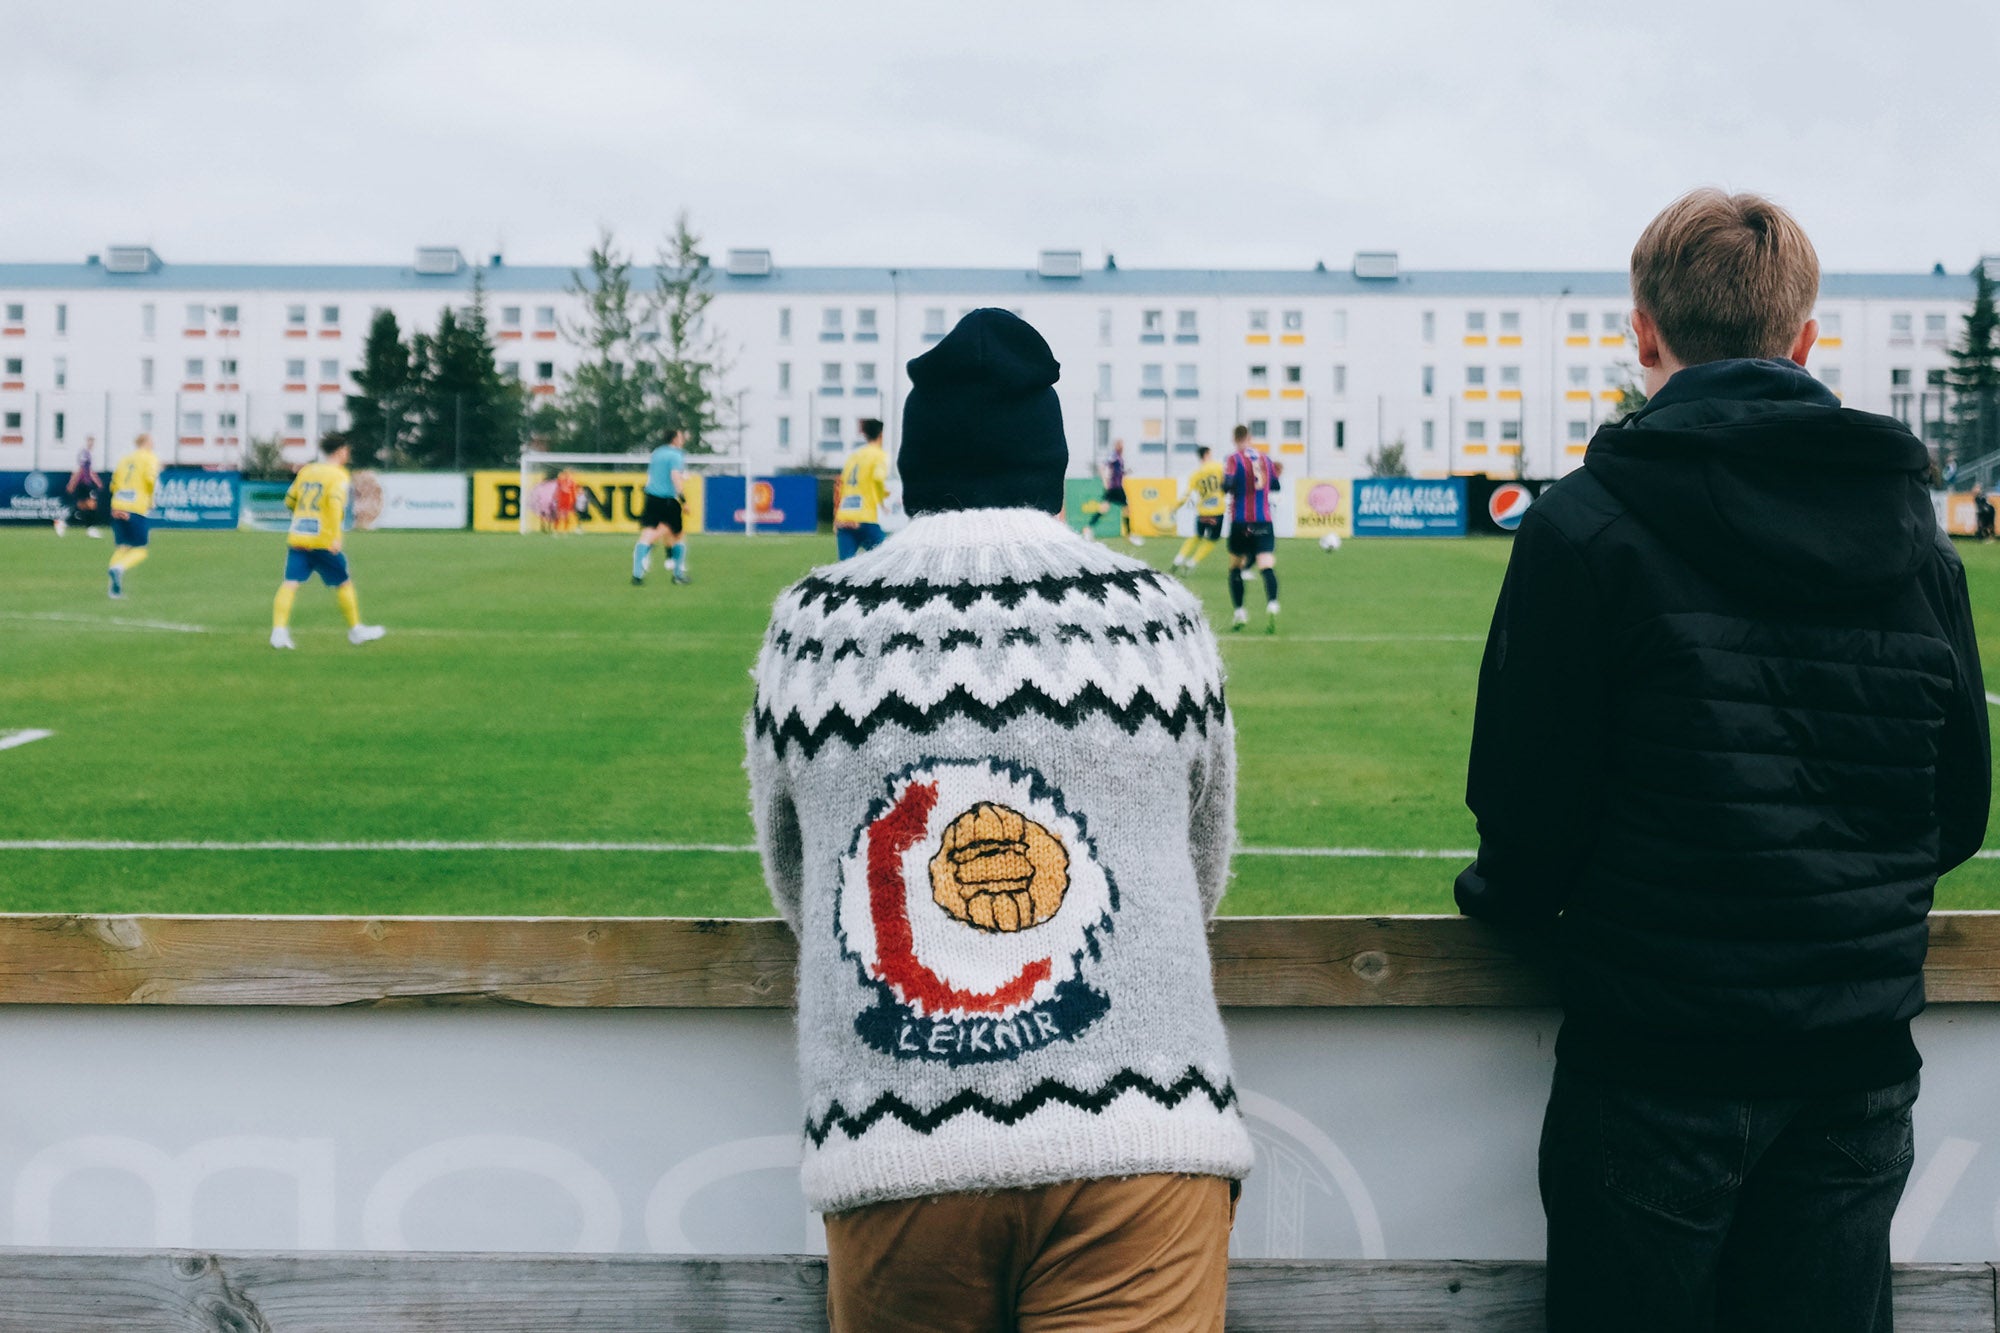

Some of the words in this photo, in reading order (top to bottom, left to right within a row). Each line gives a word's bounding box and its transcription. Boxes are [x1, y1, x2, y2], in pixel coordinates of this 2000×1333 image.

[847, 463, 859, 487] 4
[298, 482, 323, 511] 22
[497, 485, 645, 520] BNU
[898, 1011, 1061, 1053] LEIKNIR
